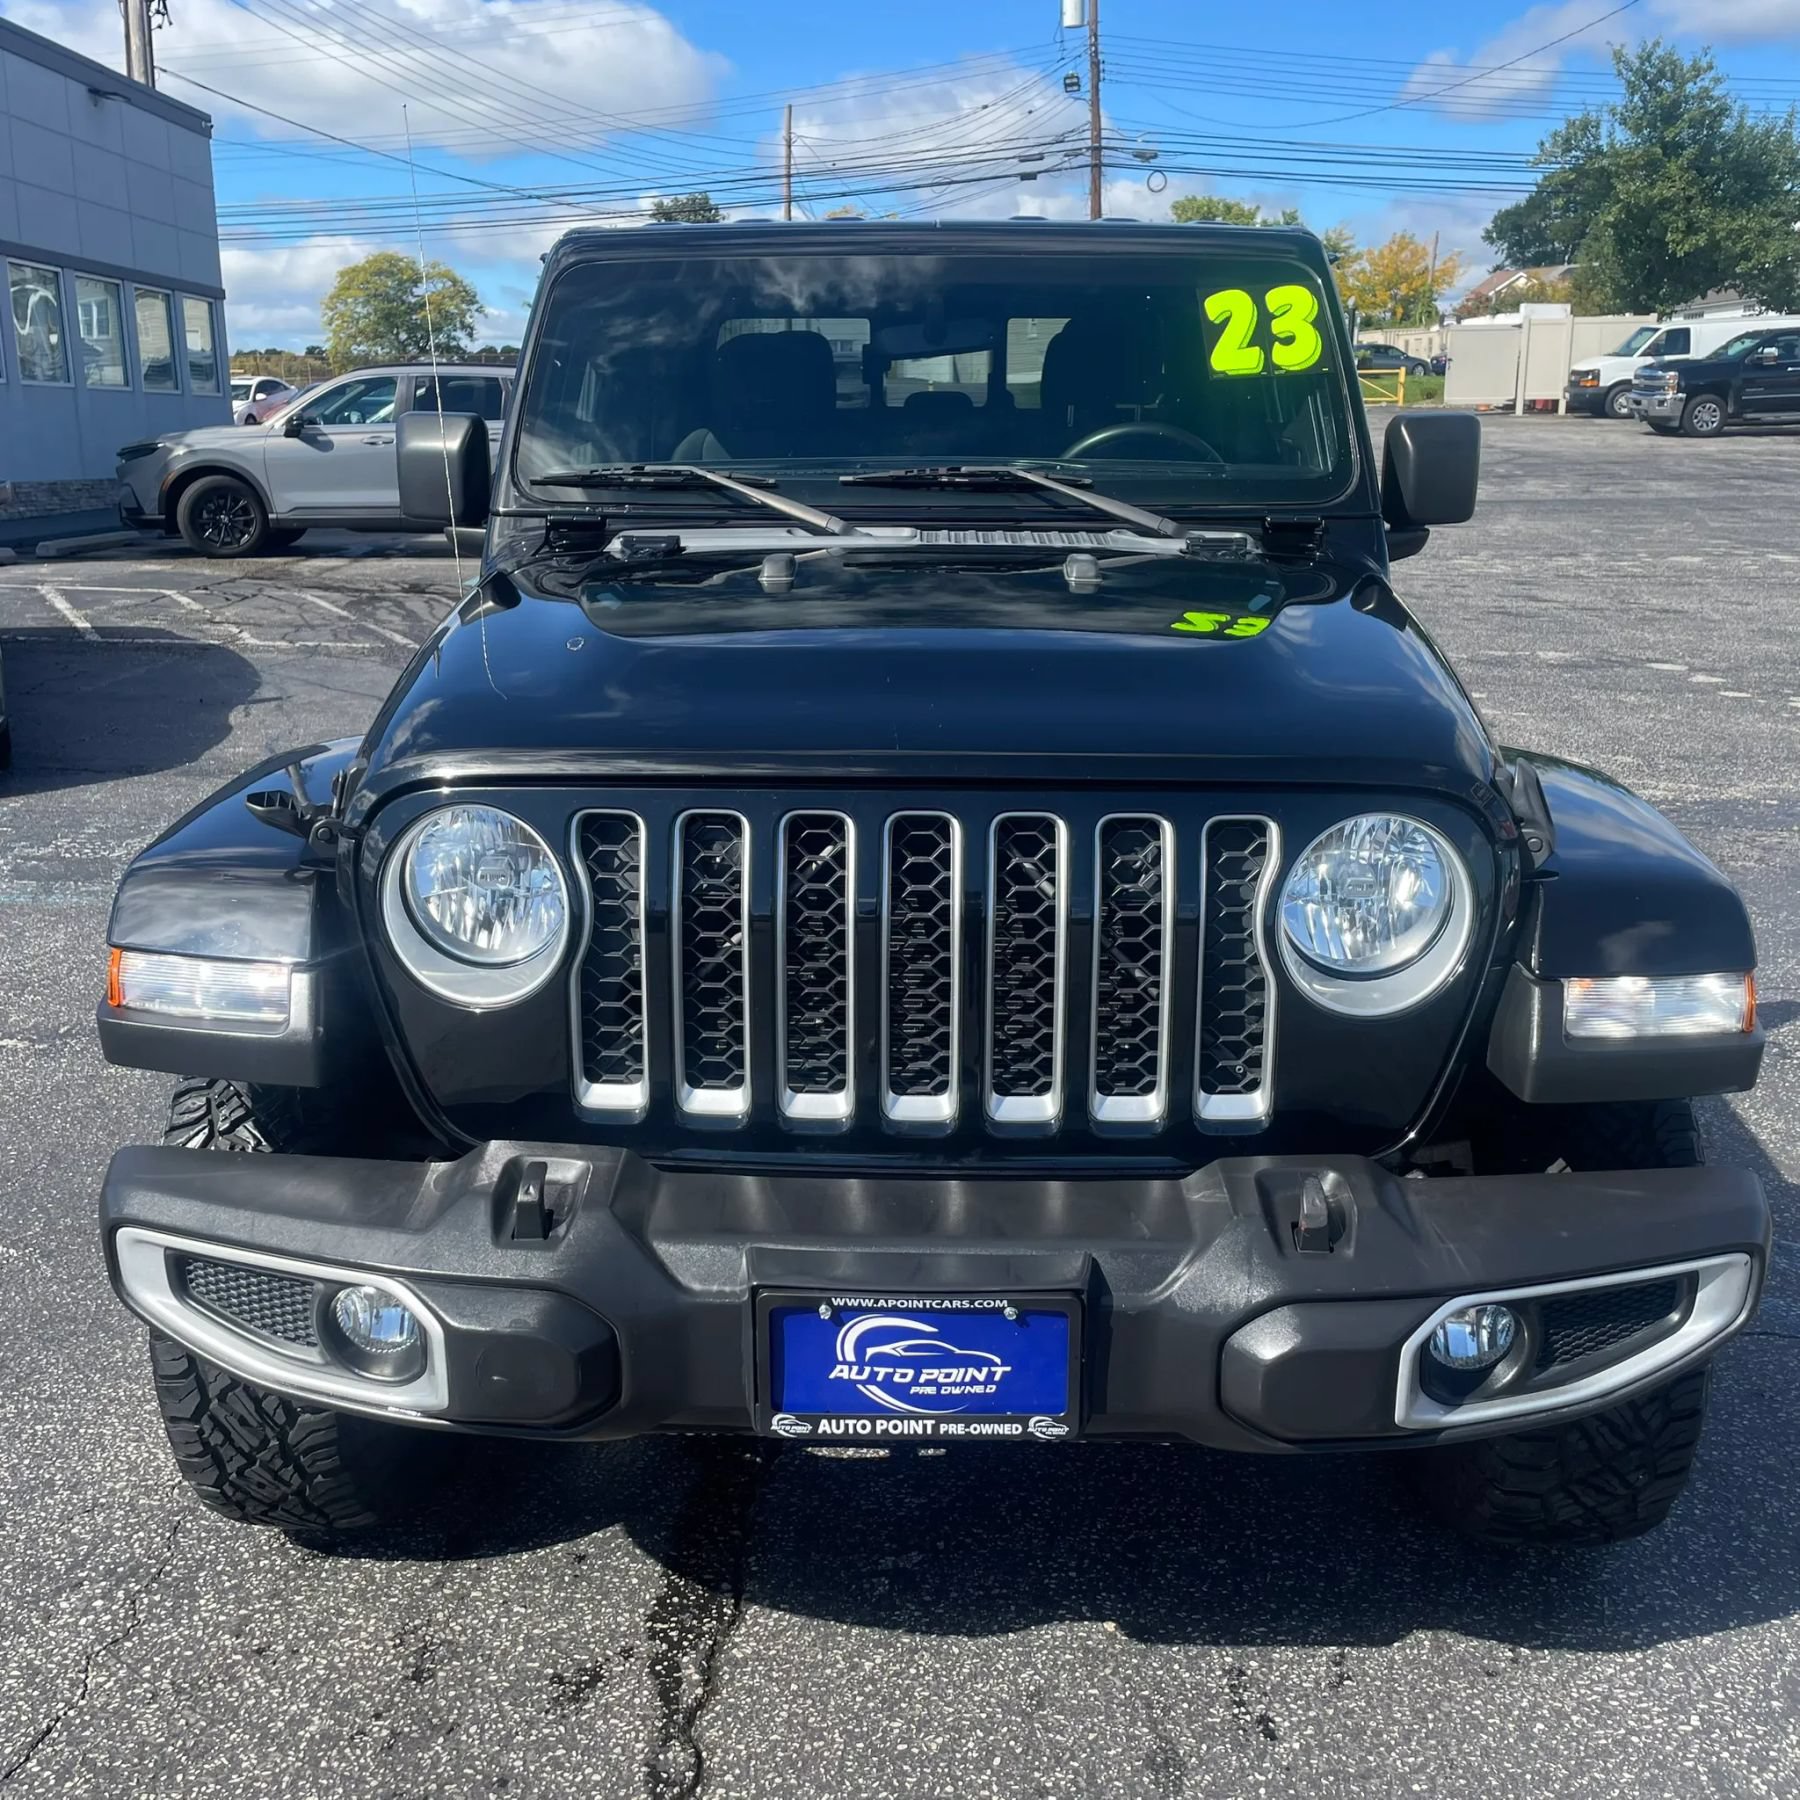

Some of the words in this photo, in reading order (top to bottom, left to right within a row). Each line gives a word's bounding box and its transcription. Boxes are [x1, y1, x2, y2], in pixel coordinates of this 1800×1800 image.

[1204, 284, 1322, 375] 23
[831, 1297, 1008, 1309] WWW.APOINTCARS.COM
[828, 1364, 914, 1383] AUTO
[918, 1366, 1012, 1384] POINT
[909, 1386, 938, 1395] PRE
[940, 1384, 997, 1395] OWNED
[818, 1419, 872, 1434] AUTO
[876, 1419, 936, 1434] POINT
[940, 1423, 1022, 1435] PRE-OWNED
